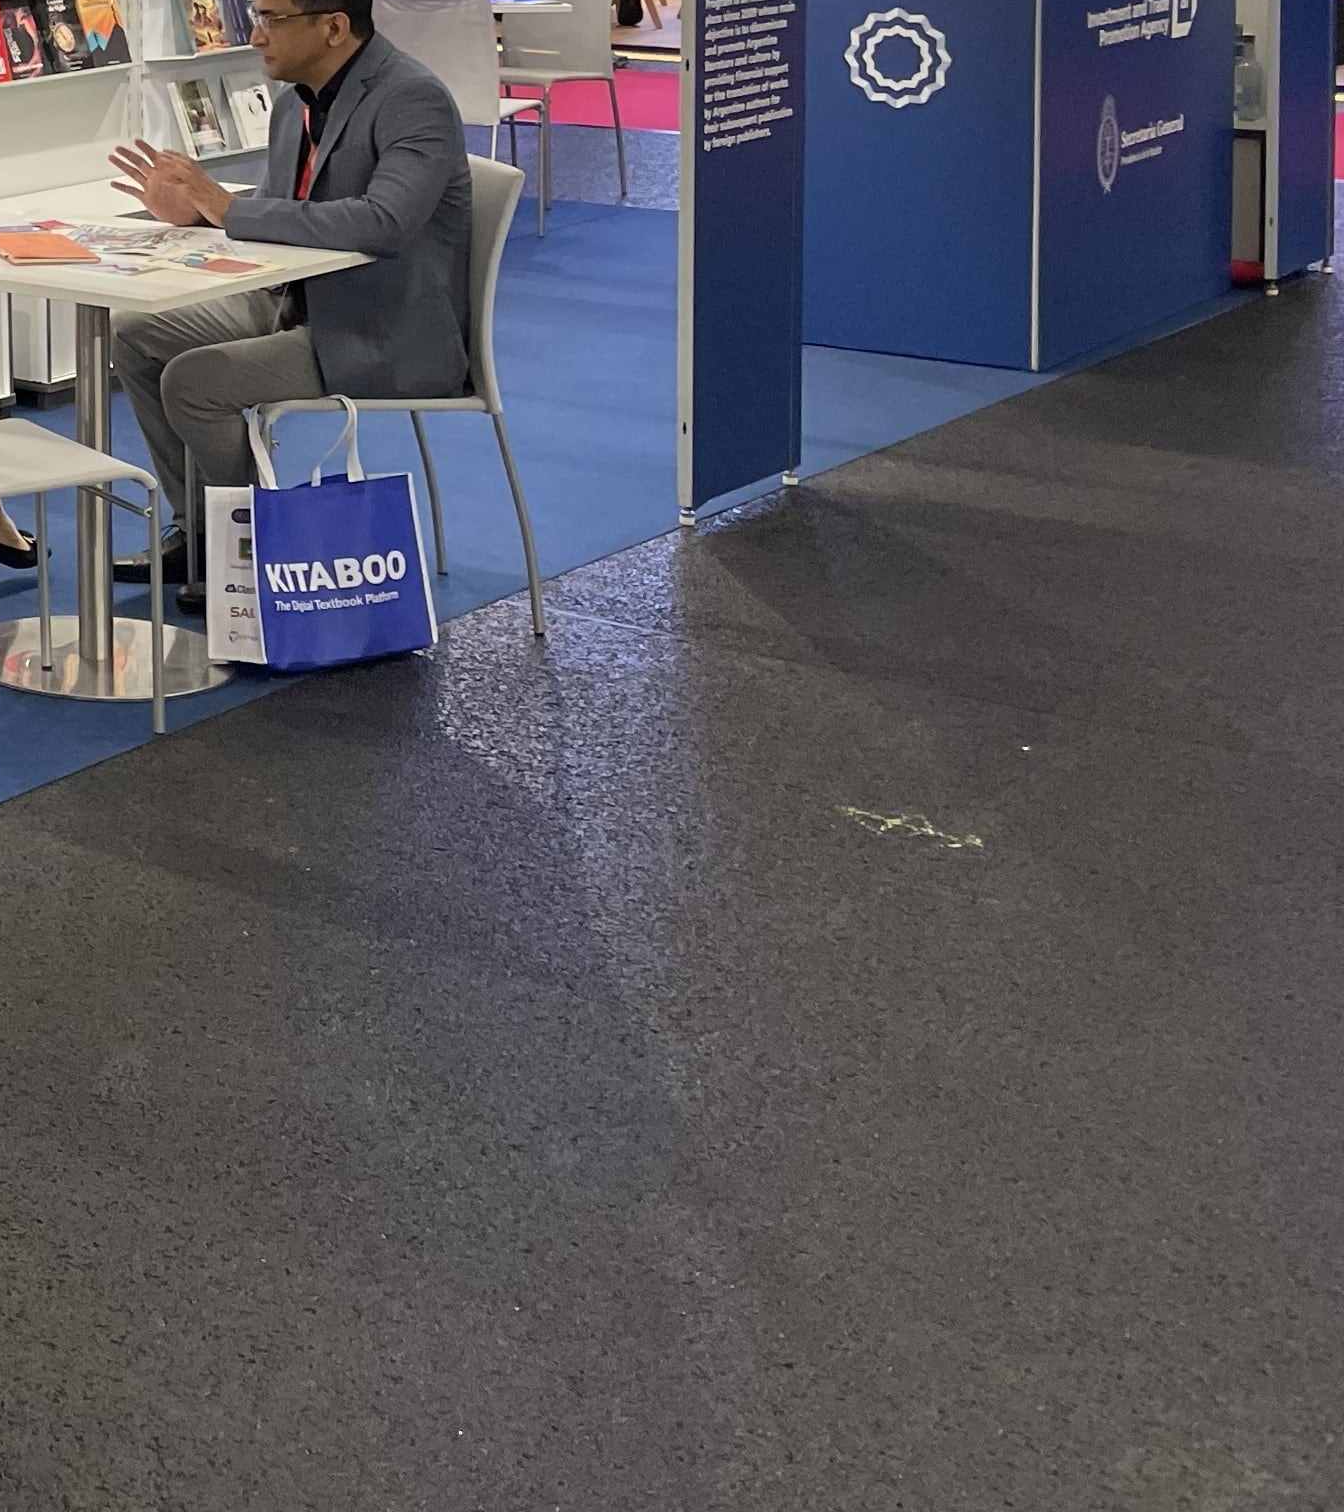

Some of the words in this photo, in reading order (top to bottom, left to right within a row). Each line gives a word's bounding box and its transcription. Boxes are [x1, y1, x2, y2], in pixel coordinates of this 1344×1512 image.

[265, 550, 406, 592] KITABOO
[275, 601, 291, 611] The
[315, 595, 363, 610] Textbook
[365, 591, 399, 604] Platform
